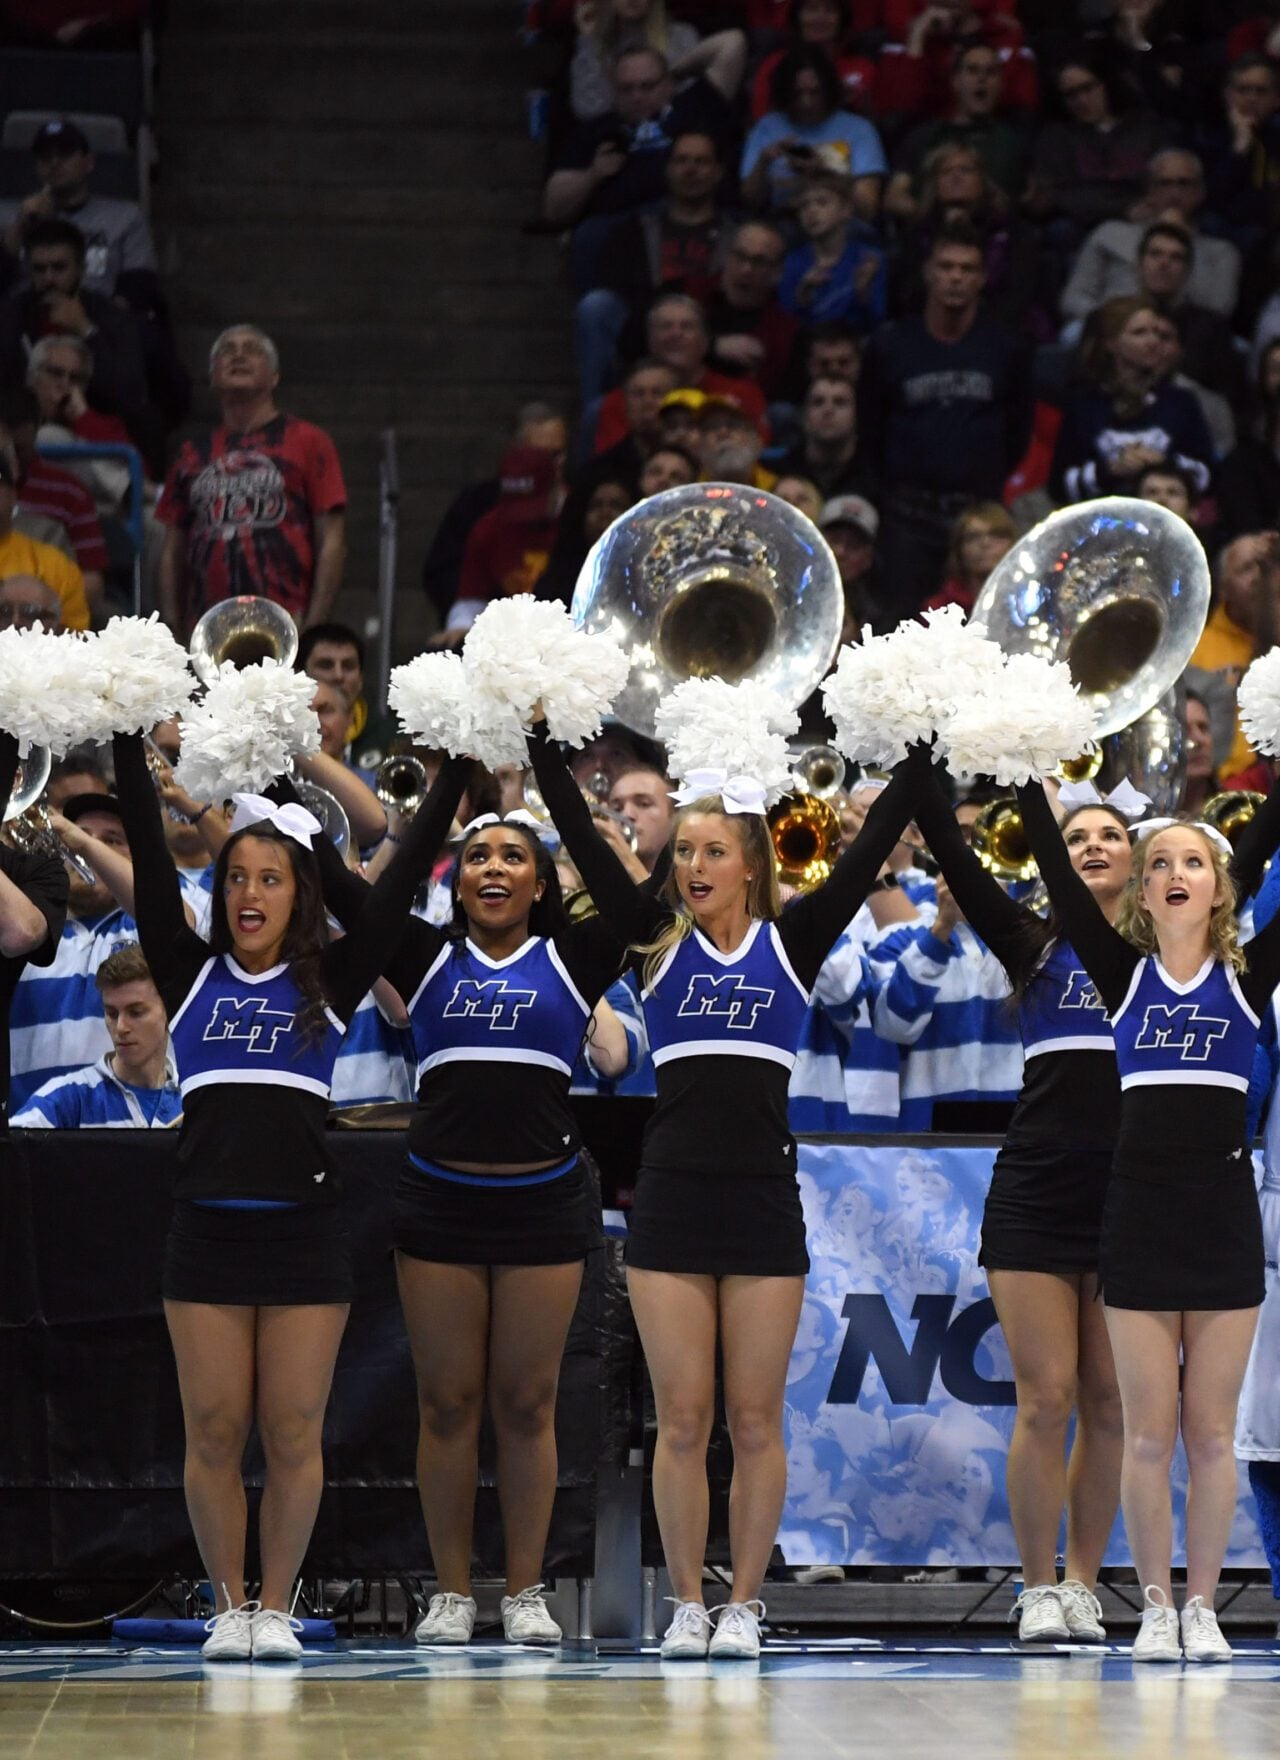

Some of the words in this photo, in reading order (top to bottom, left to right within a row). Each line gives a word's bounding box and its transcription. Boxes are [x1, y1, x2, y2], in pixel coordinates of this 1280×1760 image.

[443, 979, 538, 1030] MT
[677, 974, 776, 1030] MT
[1059, 971, 1112, 1021] M
[203, 997, 296, 1053] MT
[1135, 1004, 1231, 1061] MT
